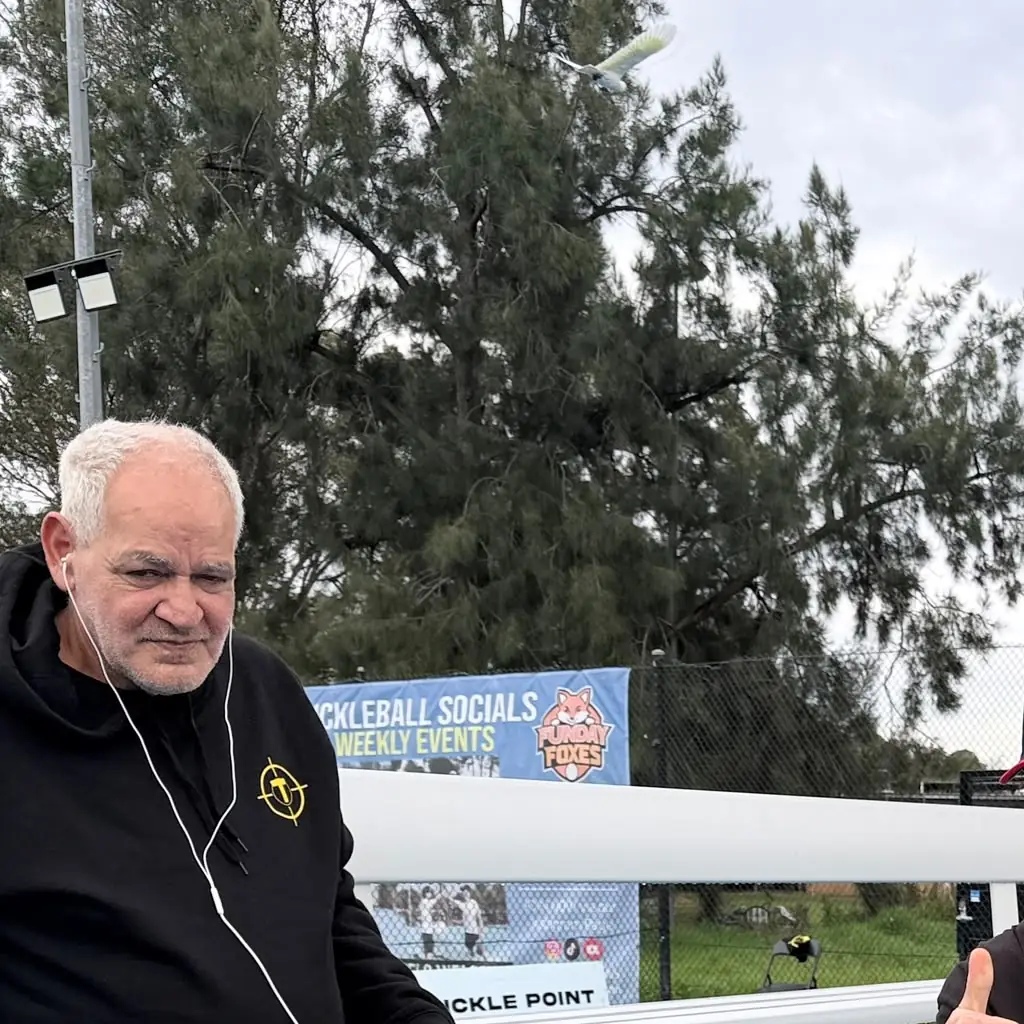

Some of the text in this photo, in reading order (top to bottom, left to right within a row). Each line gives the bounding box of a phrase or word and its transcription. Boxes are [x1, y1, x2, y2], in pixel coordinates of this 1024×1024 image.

[437, 691, 538, 725] SOCIALS
[334, 726, 495, 756] WEEKLY EVENTS
[537, 725, 608, 748] FUNDAY
[544, 744, 601, 767] FOXES
[527, 990, 594, 1007] POINT
